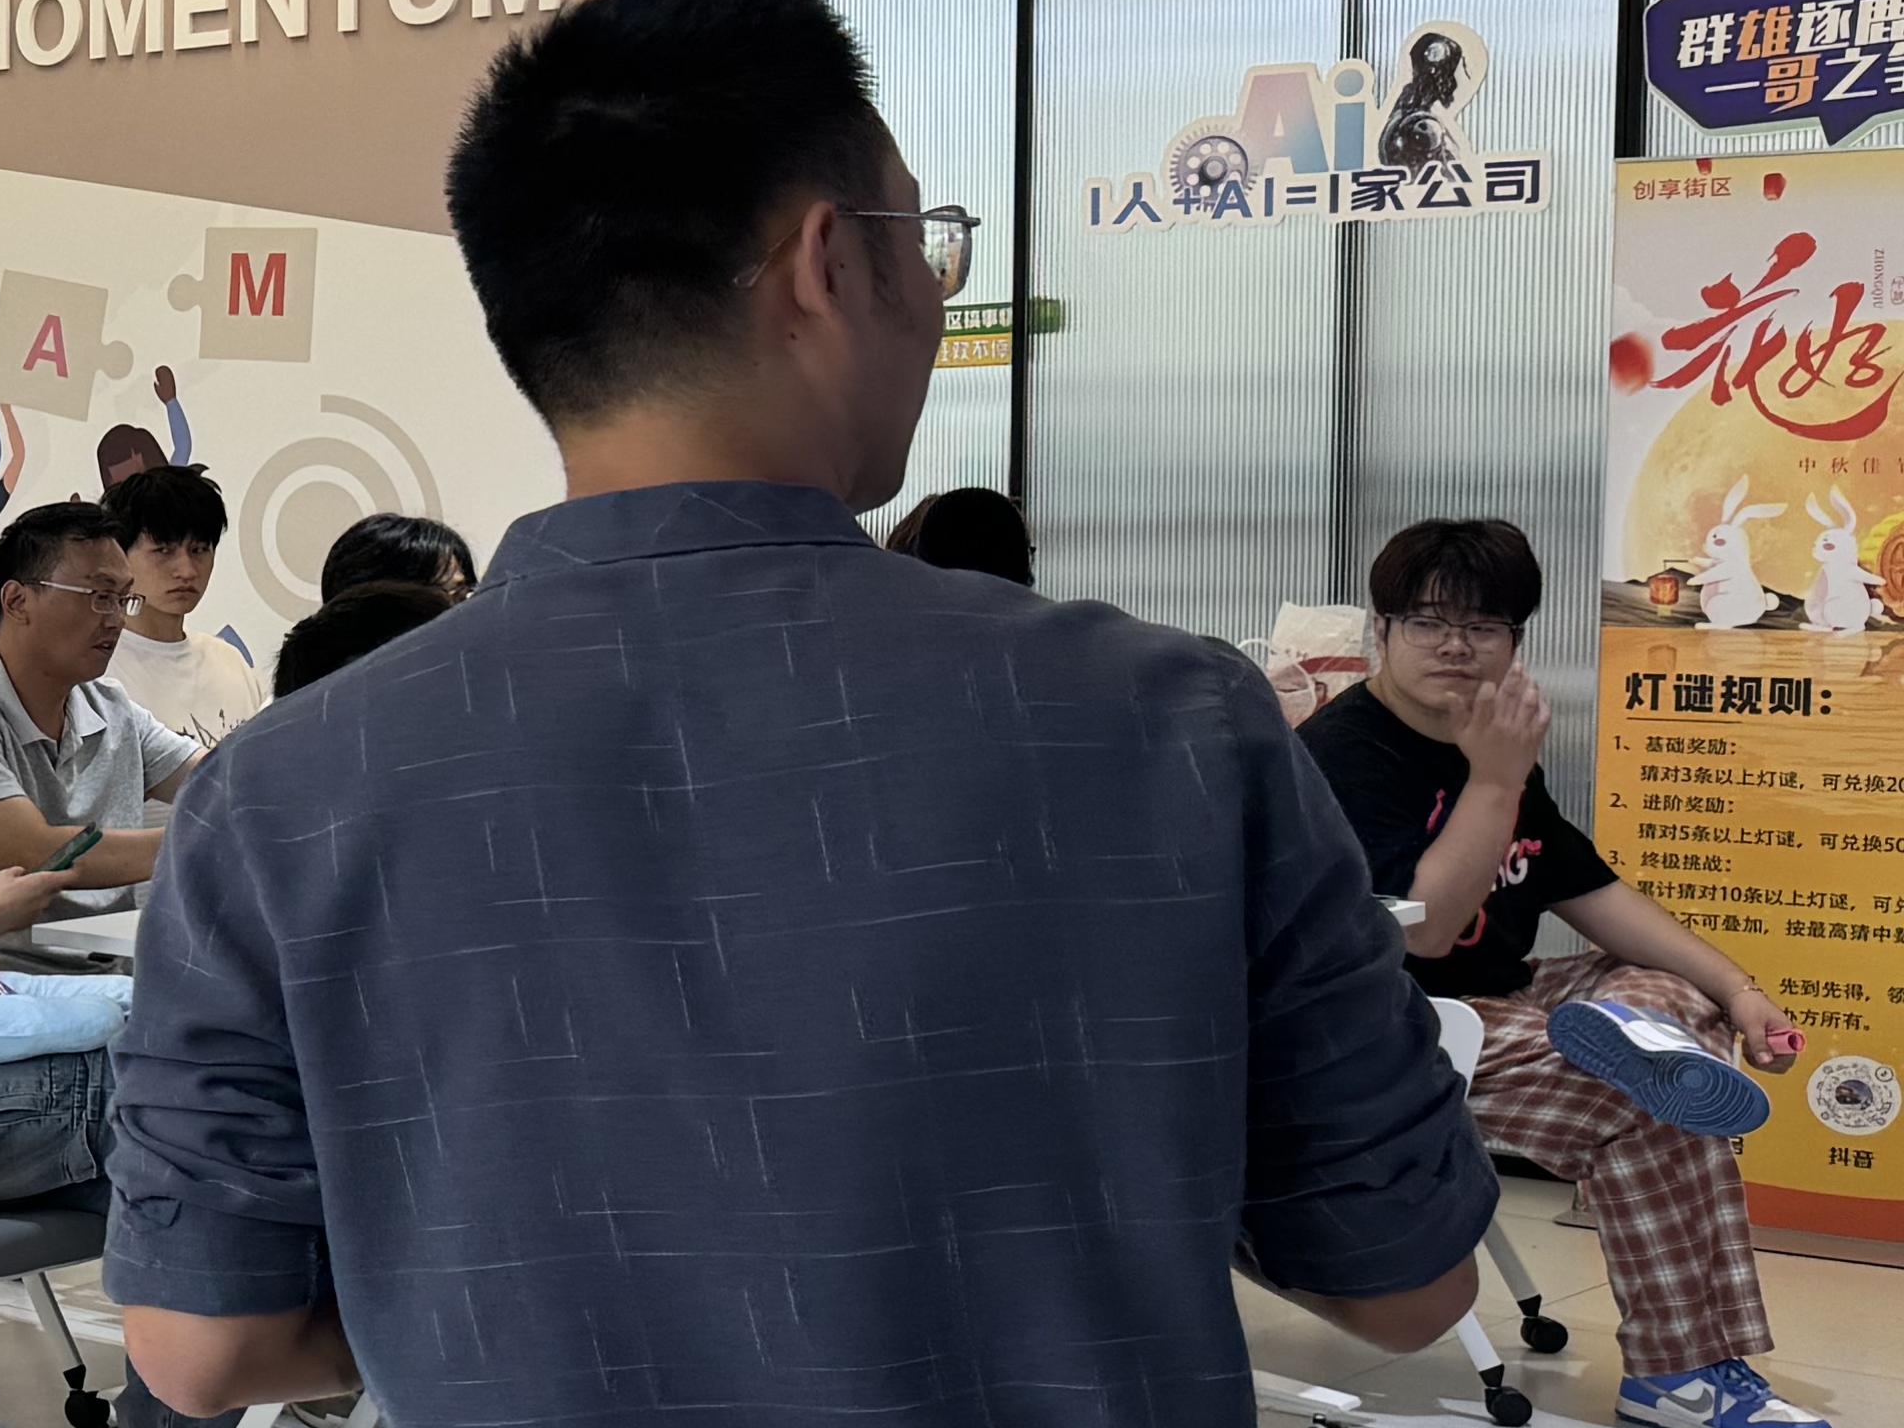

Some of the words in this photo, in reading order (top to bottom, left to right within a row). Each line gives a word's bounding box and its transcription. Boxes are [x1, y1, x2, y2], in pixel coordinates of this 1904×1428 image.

[1633, 176, 1732, 200] 创享街区
[1625, 672, 1833, 716] 灯谜规则：
[1828, 1146, 1874, 1169] 抖音
